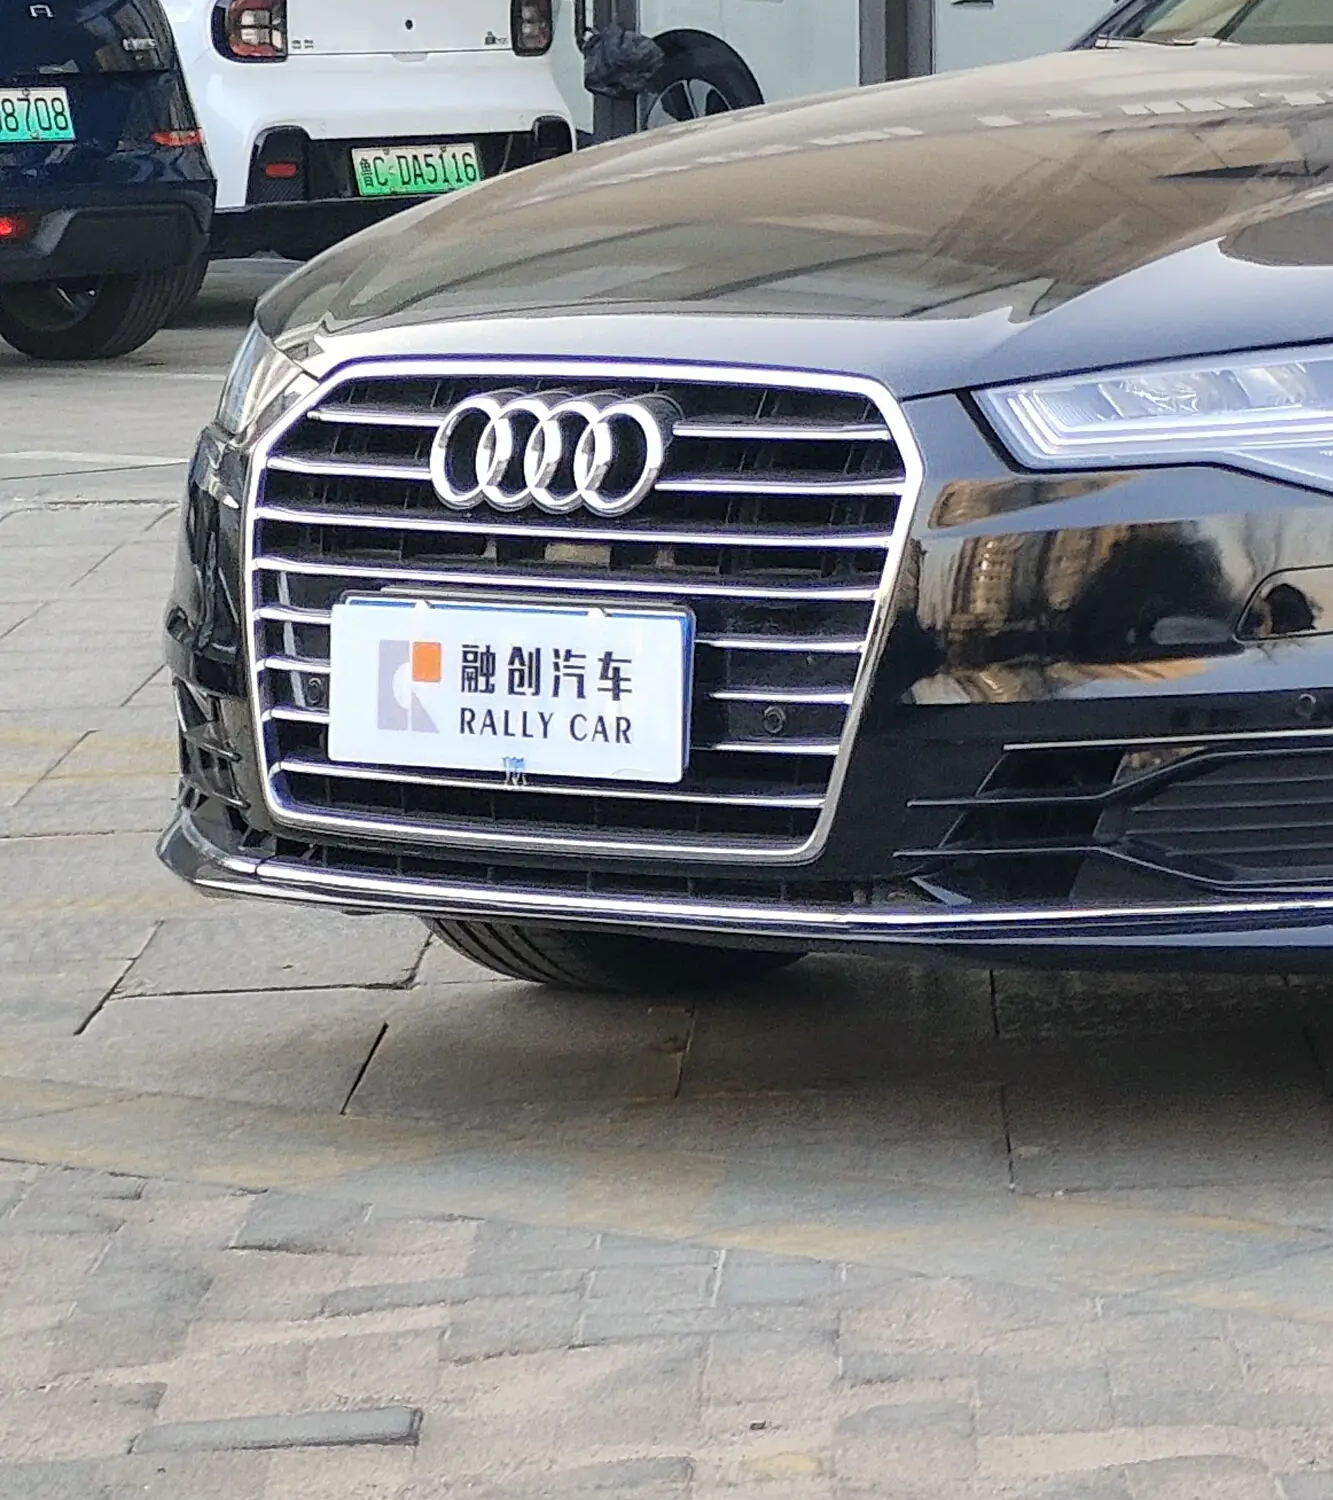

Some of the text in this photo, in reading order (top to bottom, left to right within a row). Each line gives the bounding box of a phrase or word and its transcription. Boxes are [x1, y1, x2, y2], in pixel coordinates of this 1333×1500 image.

[460, 643, 633, 701] 融创汽车
[459, 706, 633, 746] RALLY CAR
